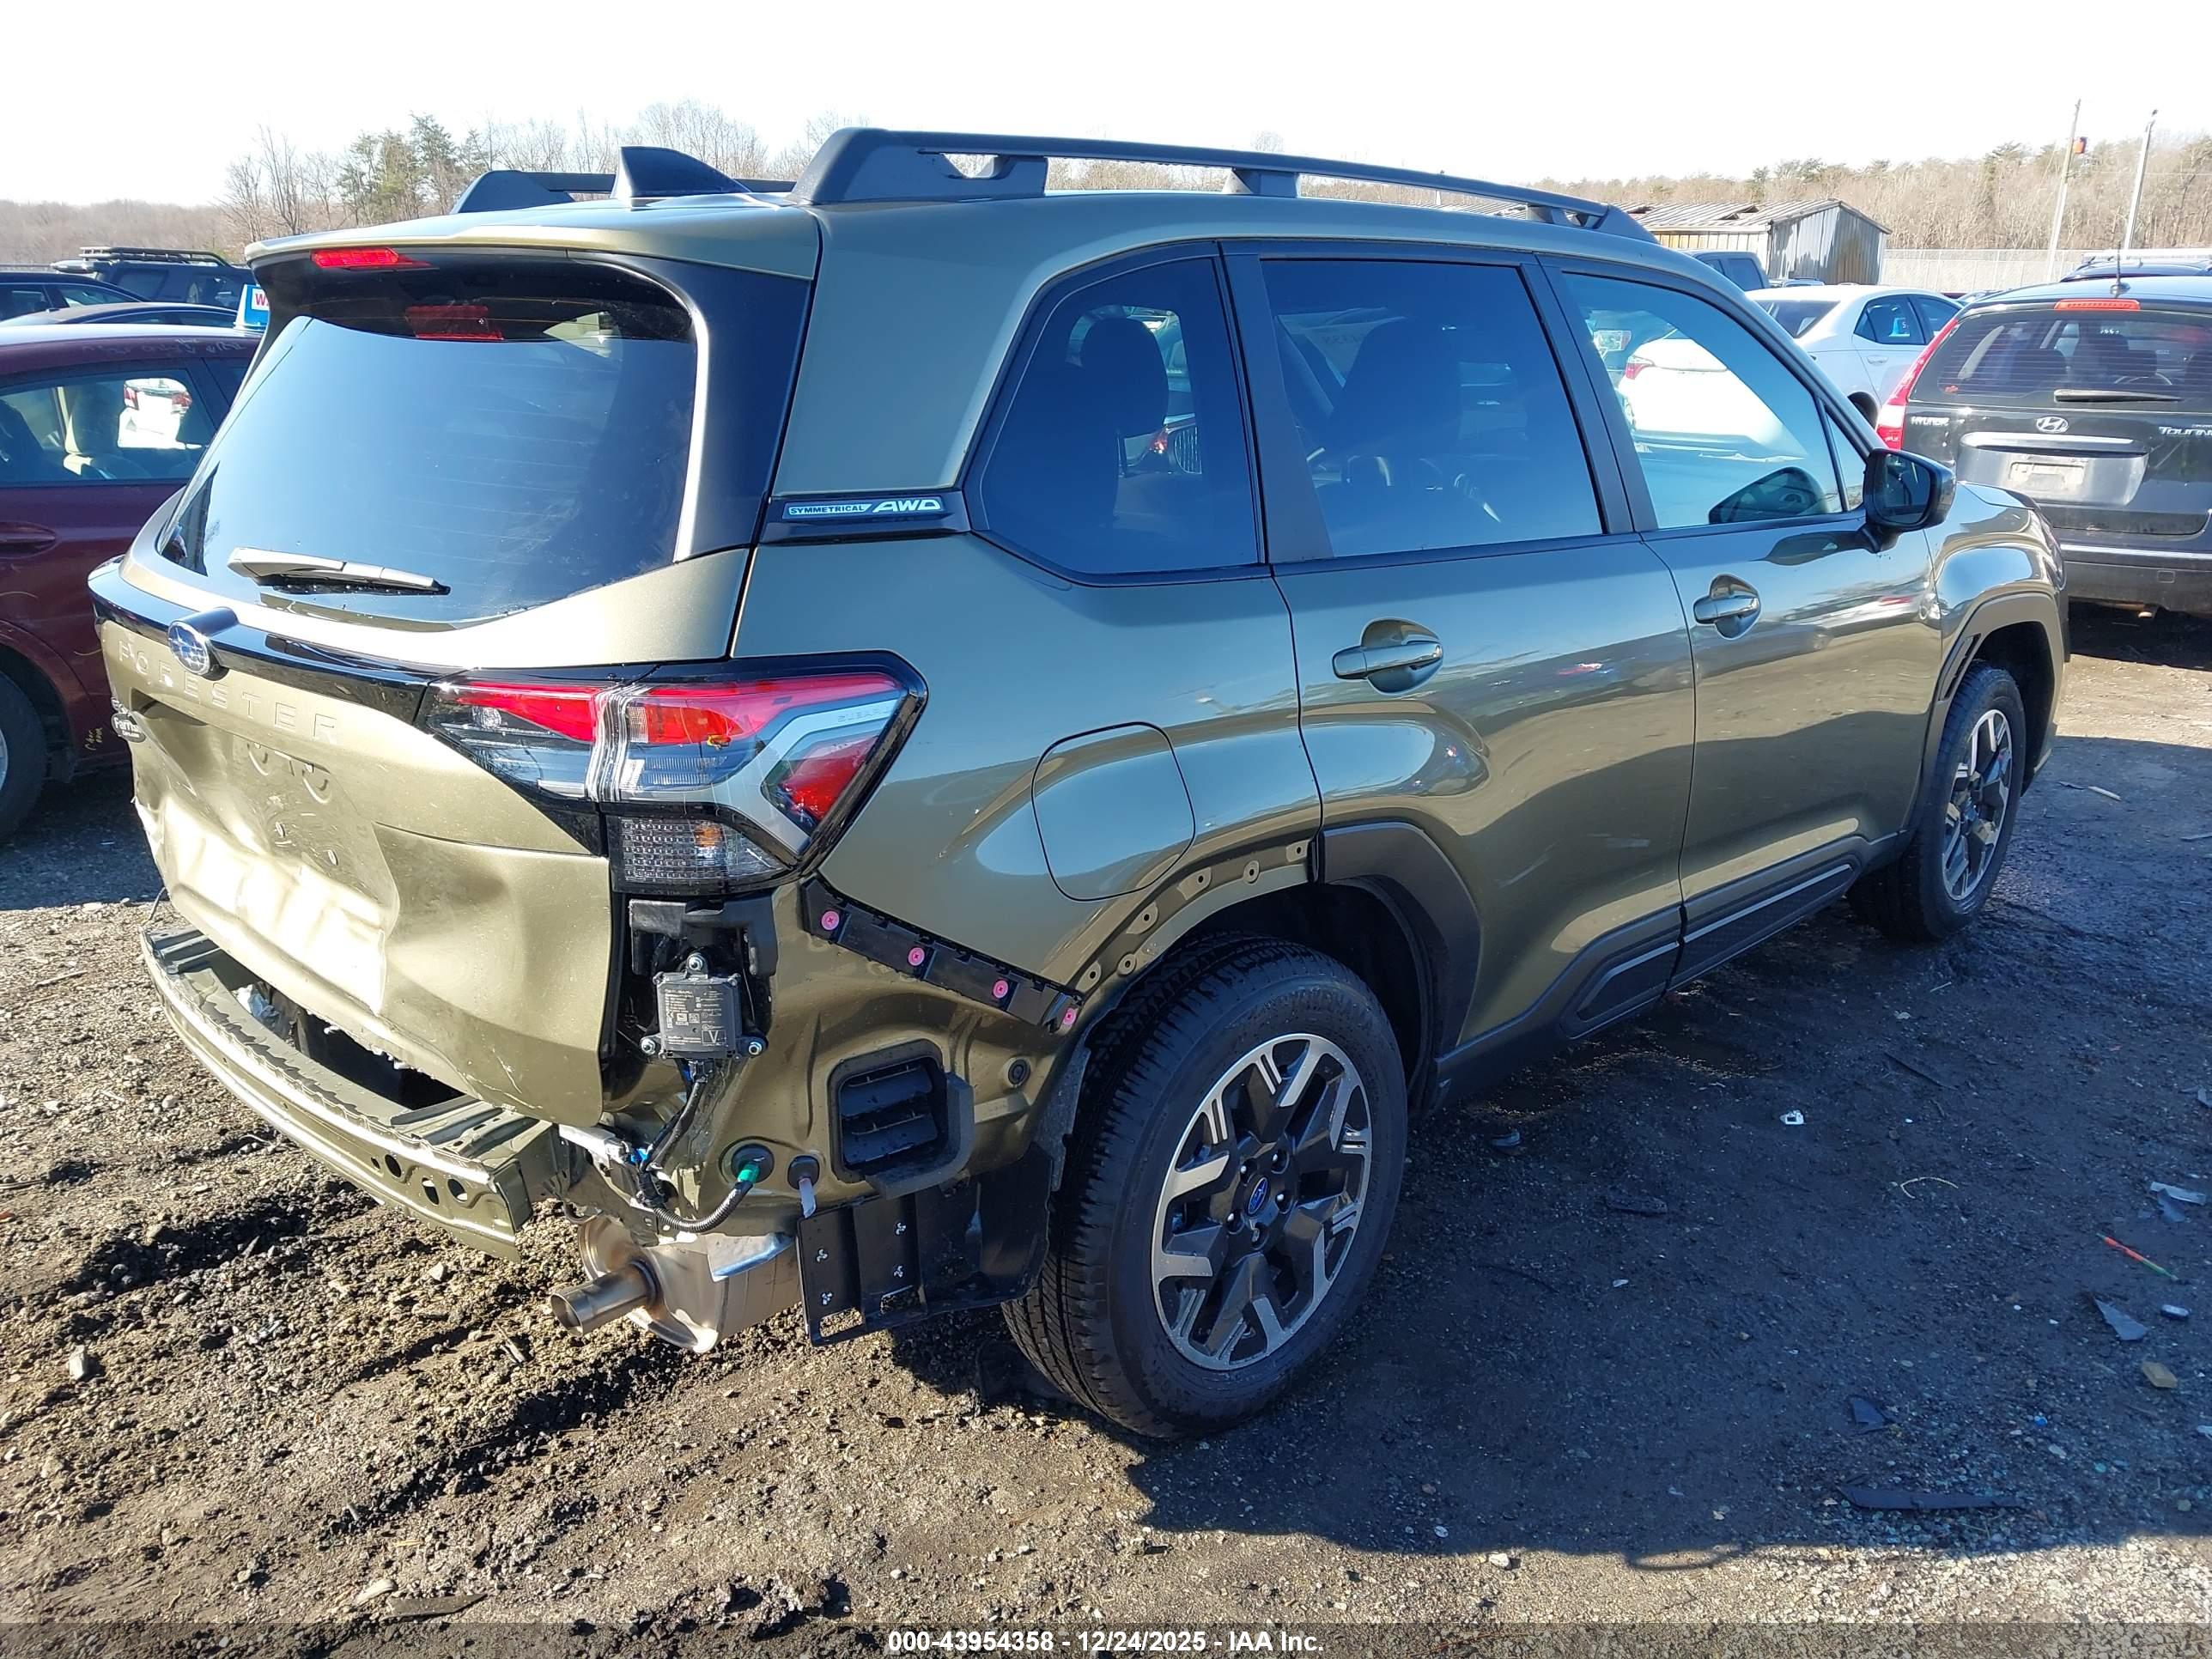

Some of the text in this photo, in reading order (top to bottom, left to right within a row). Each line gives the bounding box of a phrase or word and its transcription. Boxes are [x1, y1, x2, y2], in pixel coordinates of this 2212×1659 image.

[790, 498, 942, 514] SYMMETRICAL AWD
[118, 640, 337, 745] FORESTER
